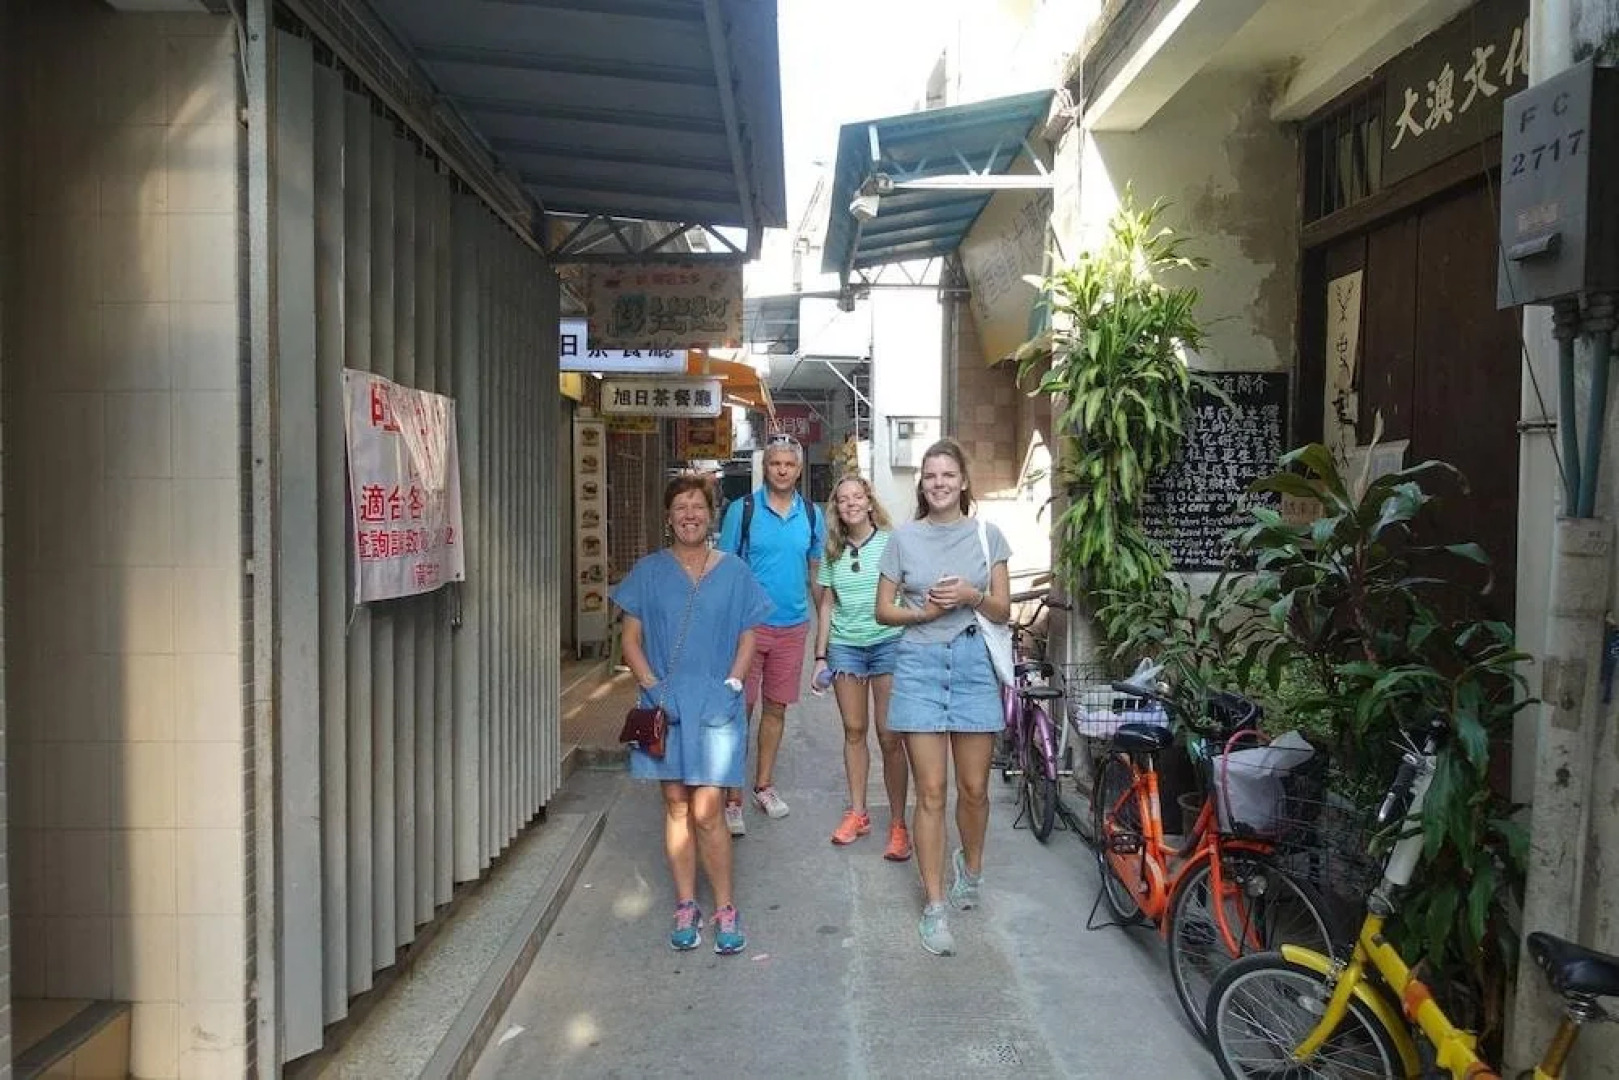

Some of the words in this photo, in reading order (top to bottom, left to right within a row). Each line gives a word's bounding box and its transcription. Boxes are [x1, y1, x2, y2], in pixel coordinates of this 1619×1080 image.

[1511, 128, 1586, 176] 2717
[613, 387, 713, 408] 旭日茶餐廳
